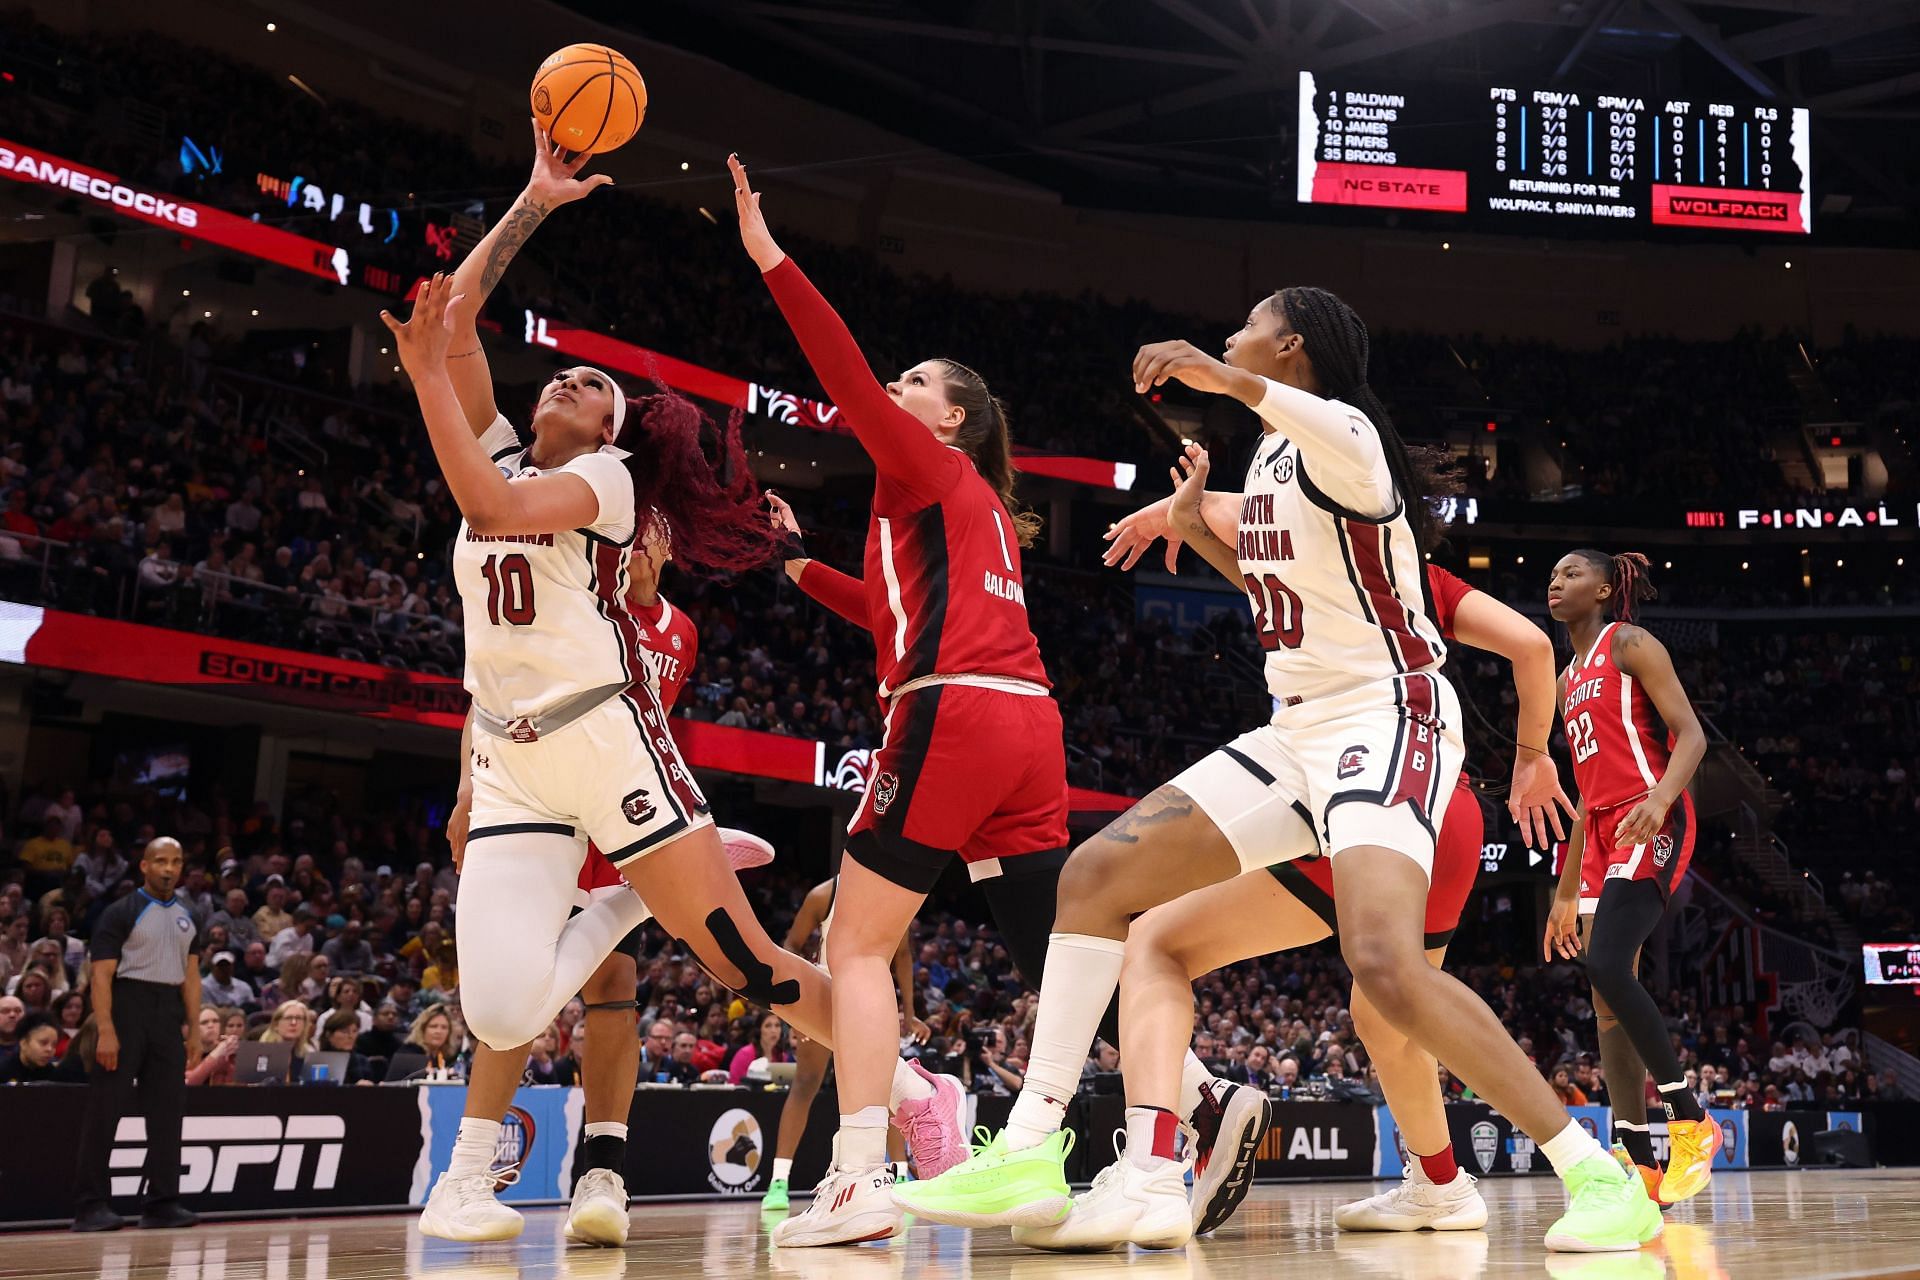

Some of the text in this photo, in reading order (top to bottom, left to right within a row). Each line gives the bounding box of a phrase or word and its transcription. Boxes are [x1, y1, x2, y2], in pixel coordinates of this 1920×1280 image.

[1328, 105, 1397, 121] 2 COLLINS
[1329, 91, 1404, 108] 1 BALDWIN
[1490, 87, 1778, 121] PTS FGM/A 3PM/A AST REB FLS
[1325, 119, 1388, 135] 10 JAMES
[1495, 103, 1771, 134] 6 3/8 0/0 0 2 0
[1496, 117, 1771, 148] 3 1/1 0/0 0 4 0
[1323, 148, 1397, 164] 35 BROOKS
[1324, 133, 1388, 149] 22 RIVERS
[1496, 131, 1770, 162] 8 3/8 2/5 0 1 1
[1495, 159, 1769, 189] 6 3/6 0/1 1 1 1
[1496, 145, 1771, 175] 2 1/6 0/1 1 1 0
[0, 147, 198, 228] GAMECOCKS
[1344, 179, 1441, 195] NC STATE
[1509, 178, 1620, 198] RETURNING FOR THE
[1555, 202, 1594, 215] SANIYA
[1595, 204, 1636, 218] RIVERS
[1672, 200, 1785, 217] WOLFPACK
[1241, 494, 1274, 525] OUTH
[1686, 511, 1724, 527] WOMEN'S
[992, 508, 1013, 572] 1
[1237, 530, 1295, 561] ROLINA
[480, 553, 536, 625] 10
[984, 570, 1026, 609] BALDW
[1243, 573, 1304, 651] 20
[206, 654, 467, 713] SOUTH CAROLIN
[1569, 677, 1605, 711] STATE
[1567, 711, 1599, 764] 22
[1287, 1127, 1348, 1160] ALL
